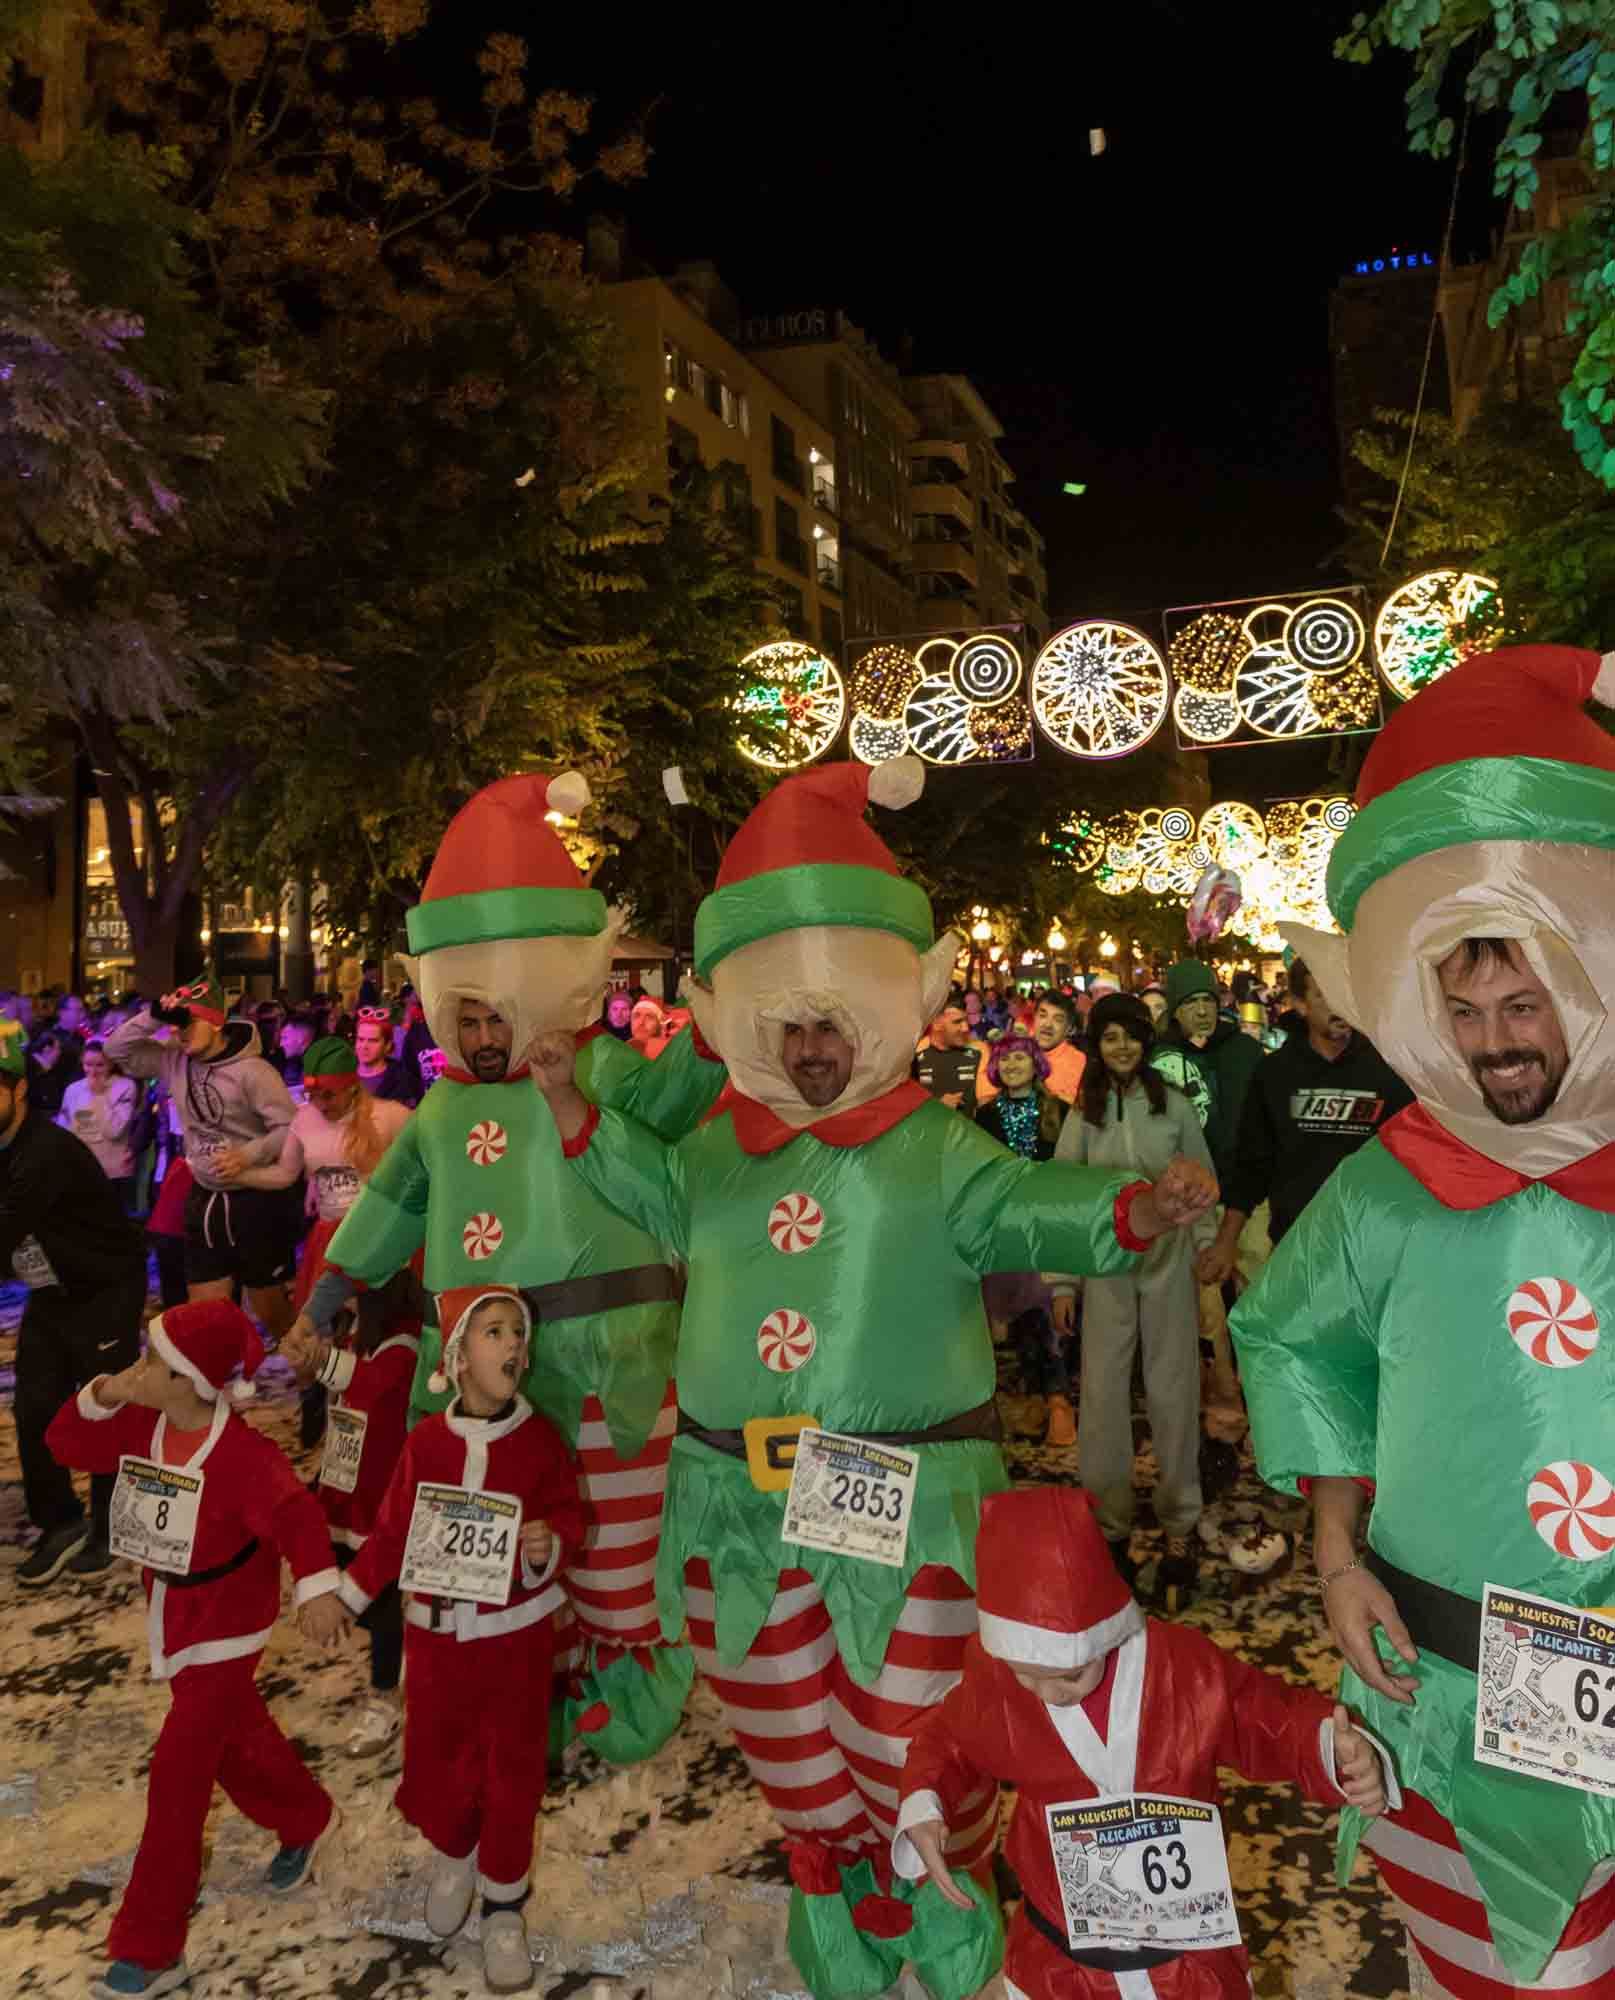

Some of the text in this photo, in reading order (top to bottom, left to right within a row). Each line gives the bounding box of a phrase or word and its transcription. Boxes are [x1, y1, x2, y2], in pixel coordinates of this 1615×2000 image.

[1355, 252, 1432, 273] HOTEL
[831, 1474, 903, 1521] 2853
[156, 1500, 169, 1530] 8
[444, 1521, 509, 1561] 2854
[1490, 1599, 1514, 1614] SAN
[1519, 1605, 1578, 1632] SILVESTRE
[1534, 1632, 1601, 1661] ALICANTE
[1054, 1802, 1210, 1828] SAN SILVESTRE SOLIDARIA
[1098, 1821, 1158, 1844] ALICANTE
[1142, 1840, 1192, 1895] 63
